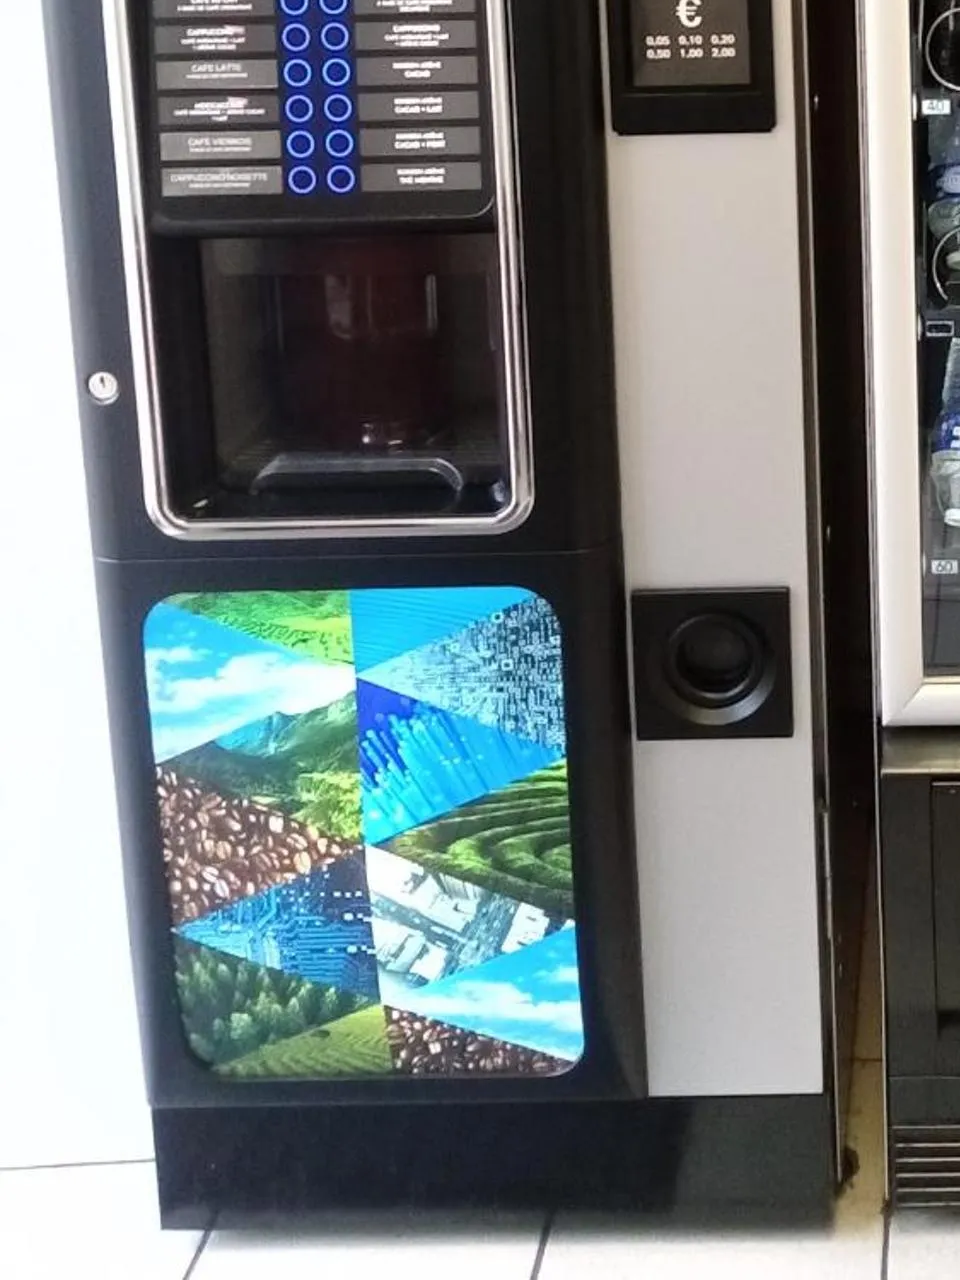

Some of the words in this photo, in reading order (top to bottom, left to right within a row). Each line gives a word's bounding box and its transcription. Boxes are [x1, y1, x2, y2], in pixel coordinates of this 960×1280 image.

[678, 34, 703, 46] 0.10
[710, 34, 736, 45] 0.20
[680, 48, 704, 58] 1.00
[711, 47, 736, 58] 2.00
